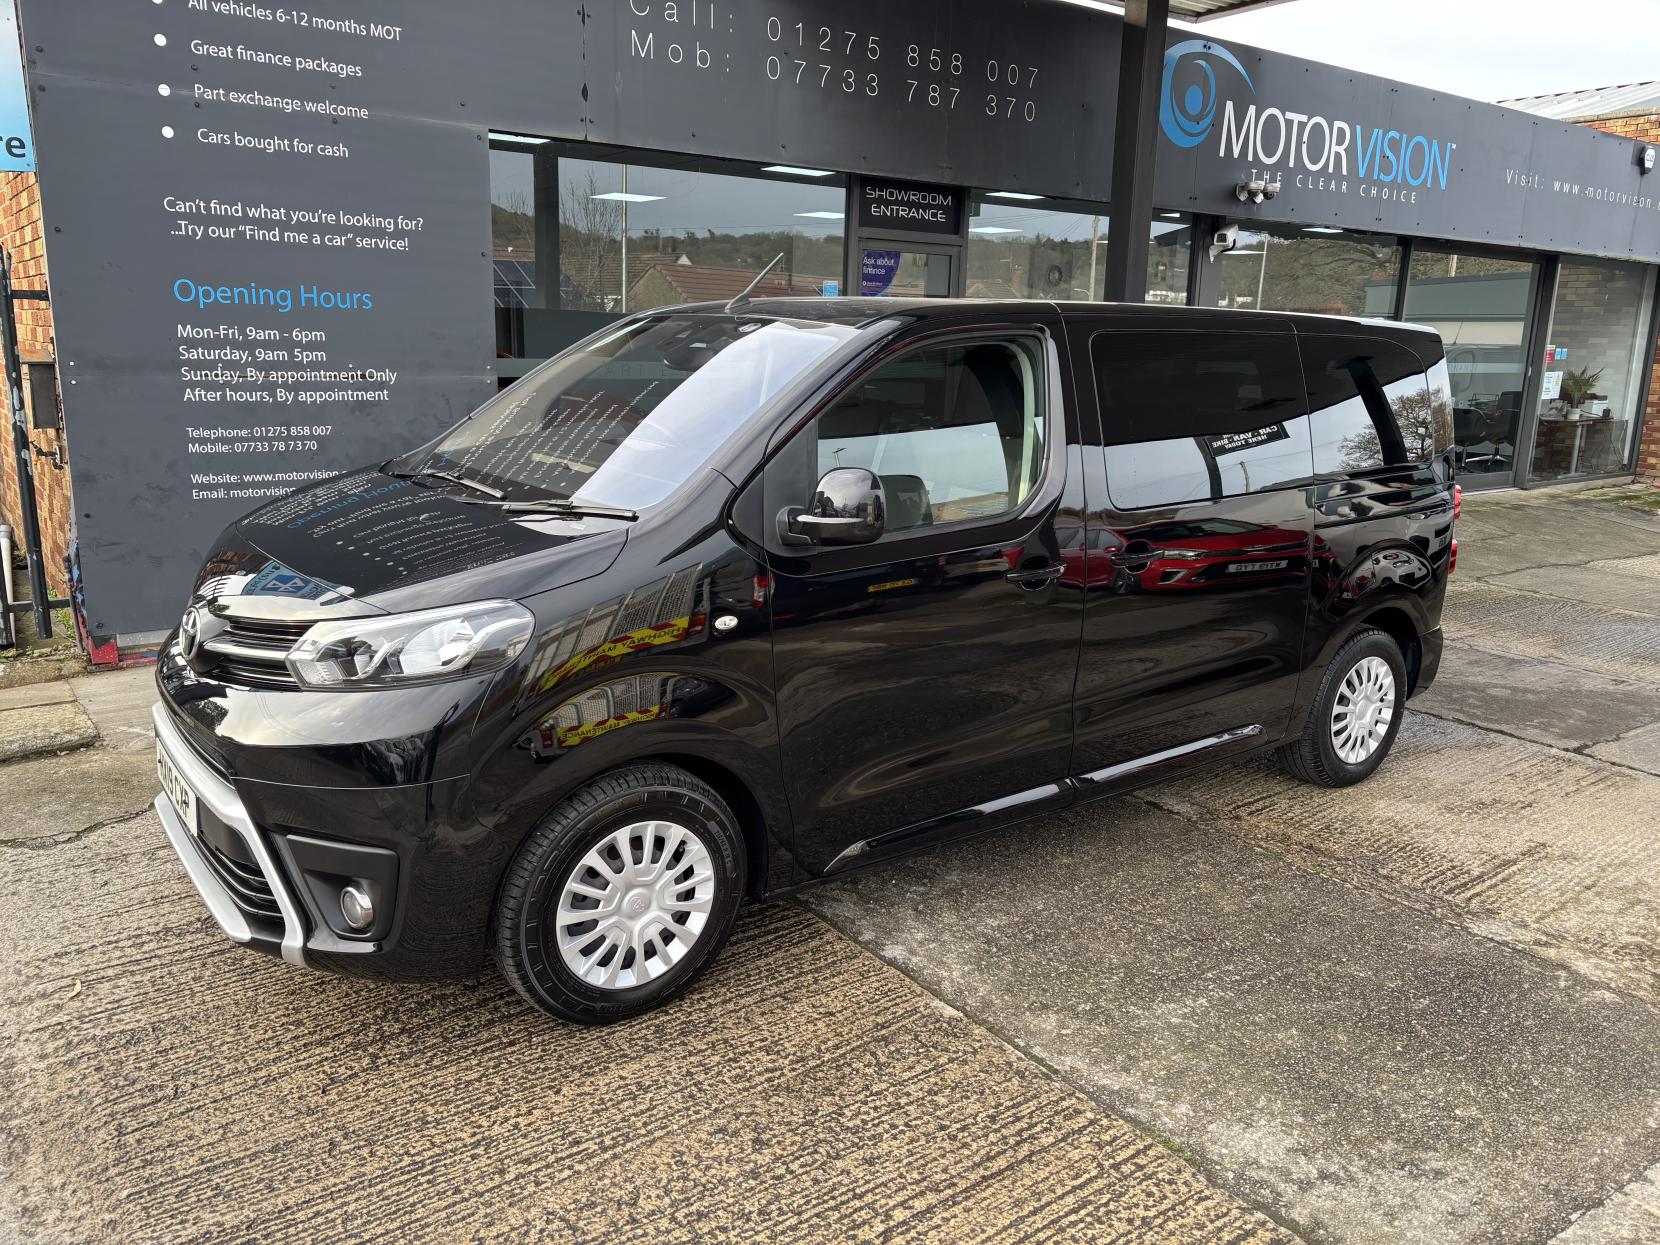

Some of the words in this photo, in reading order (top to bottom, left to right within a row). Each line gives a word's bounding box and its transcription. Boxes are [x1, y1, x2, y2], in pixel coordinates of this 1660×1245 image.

[187, 0, 208, 11] All
[211, 0, 273, 21] vehicles
[276, 8, 309, 27] 6-12
[312, 16, 367, 36] months
[370, 23, 403, 41] MOT
[190, 39, 234, 59] Great
[236, 44, 292, 67] finance
[295, 56, 362, 78] packages
[767, 16, 881, 60] 01275
[906, 44, 963, 76] 858
[986, 59, 1039, 89] 007
[631, 29, 730, 73] Mob:
[766, 55, 880, 97] 07733
[906, 79, 961, 110] 787
[985, 94, 1037, 122] 370
[194, 83, 226, 102] Part
[229, 90, 302, 113] exchange
[303, 99, 369, 119] welcome
[0, 136, 26, 158] e
[197, 128, 231, 145] Cars
[234, 131, 291, 153] bought
[292, 138, 314, 154] for
[316, 142, 349, 158] cash
[1251, 169, 1283, 185] THE
[1296, 174, 1348, 193] CLEAR
[1359, 184, 1417, 204] CHOICE
[1506, 168, 1545, 189] Visit:
[865, 186, 952, 206] SHOWROOM
[209, 199, 243, 217] find
[245, 203, 287, 221] what
[339, 210, 394, 233] looking
[397, 215, 424, 231] for?
[871, 203, 947, 222] ENTRANCE
[208, 226, 237, 239] our
[284, 231, 309, 244] me
[312, 233, 321, 245] a
[355, 235, 409, 251] service!
[862, 256, 875, 265] Ask
[876, 257, 895, 266] about
[862, 265, 886, 275] finance
[172, 278, 293, 313] Opening
[299, 284, 374, 310] Hours
[177, 323, 243, 342] Mon-Fri,
[246, 326, 280, 341] 9am
[292, 327, 326, 345] 6pm
[178, 345, 252, 364] Saturday,
[255, 348, 288, 362] 9am
[293, 348, 327, 365] 5pm
[180, 366, 243, 385] Sunday,
[246, 367, 266, 385] By
[268, 366, 363, 385] appointment
[365, 368, 398, 385] Only
[183, 387, 223, 402] After
[225, 387, 273, 404] hours,
[276, 388, 295, 405] By
[297, 388, 390, 405] appointment
[185, 426, 252, 440] Telephone:
[253, 426, 288, 437] 01275
[290, 425, 311, 437] 858
[312, 425, 332, 436] 007
[188, 442, 233, 454] Mobile:
[234, 441, 269, 453] 07733
[190, 472, 241, 484] Website:
[242, 469, 349, 483] www.motorvision
[192, 487, 228, 500] Email:
